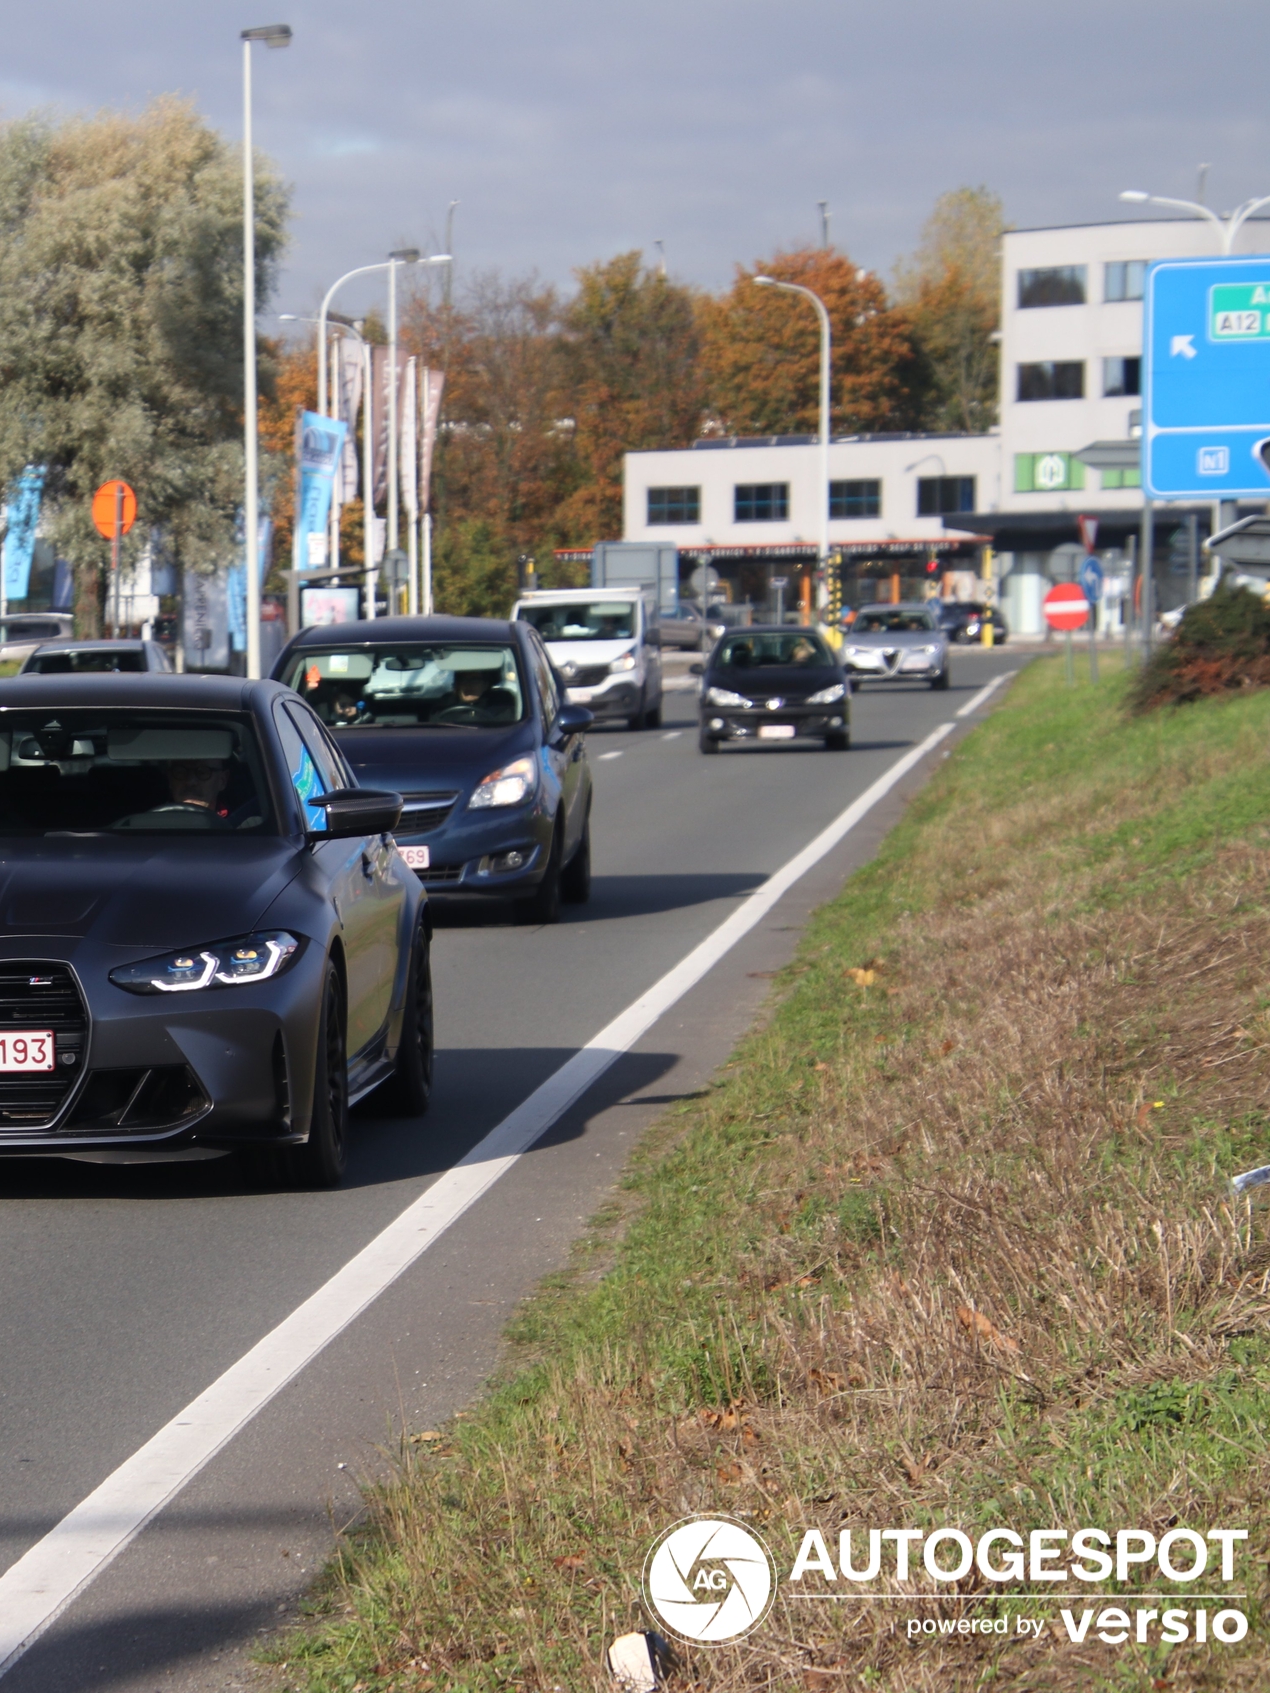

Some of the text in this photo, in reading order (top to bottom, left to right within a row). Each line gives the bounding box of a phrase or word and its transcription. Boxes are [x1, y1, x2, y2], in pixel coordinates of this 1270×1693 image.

[1251, 285, 1270, 304] A
[1220, 313, 1258, 331] A12
[1204, 450, 1224, 469] N1
